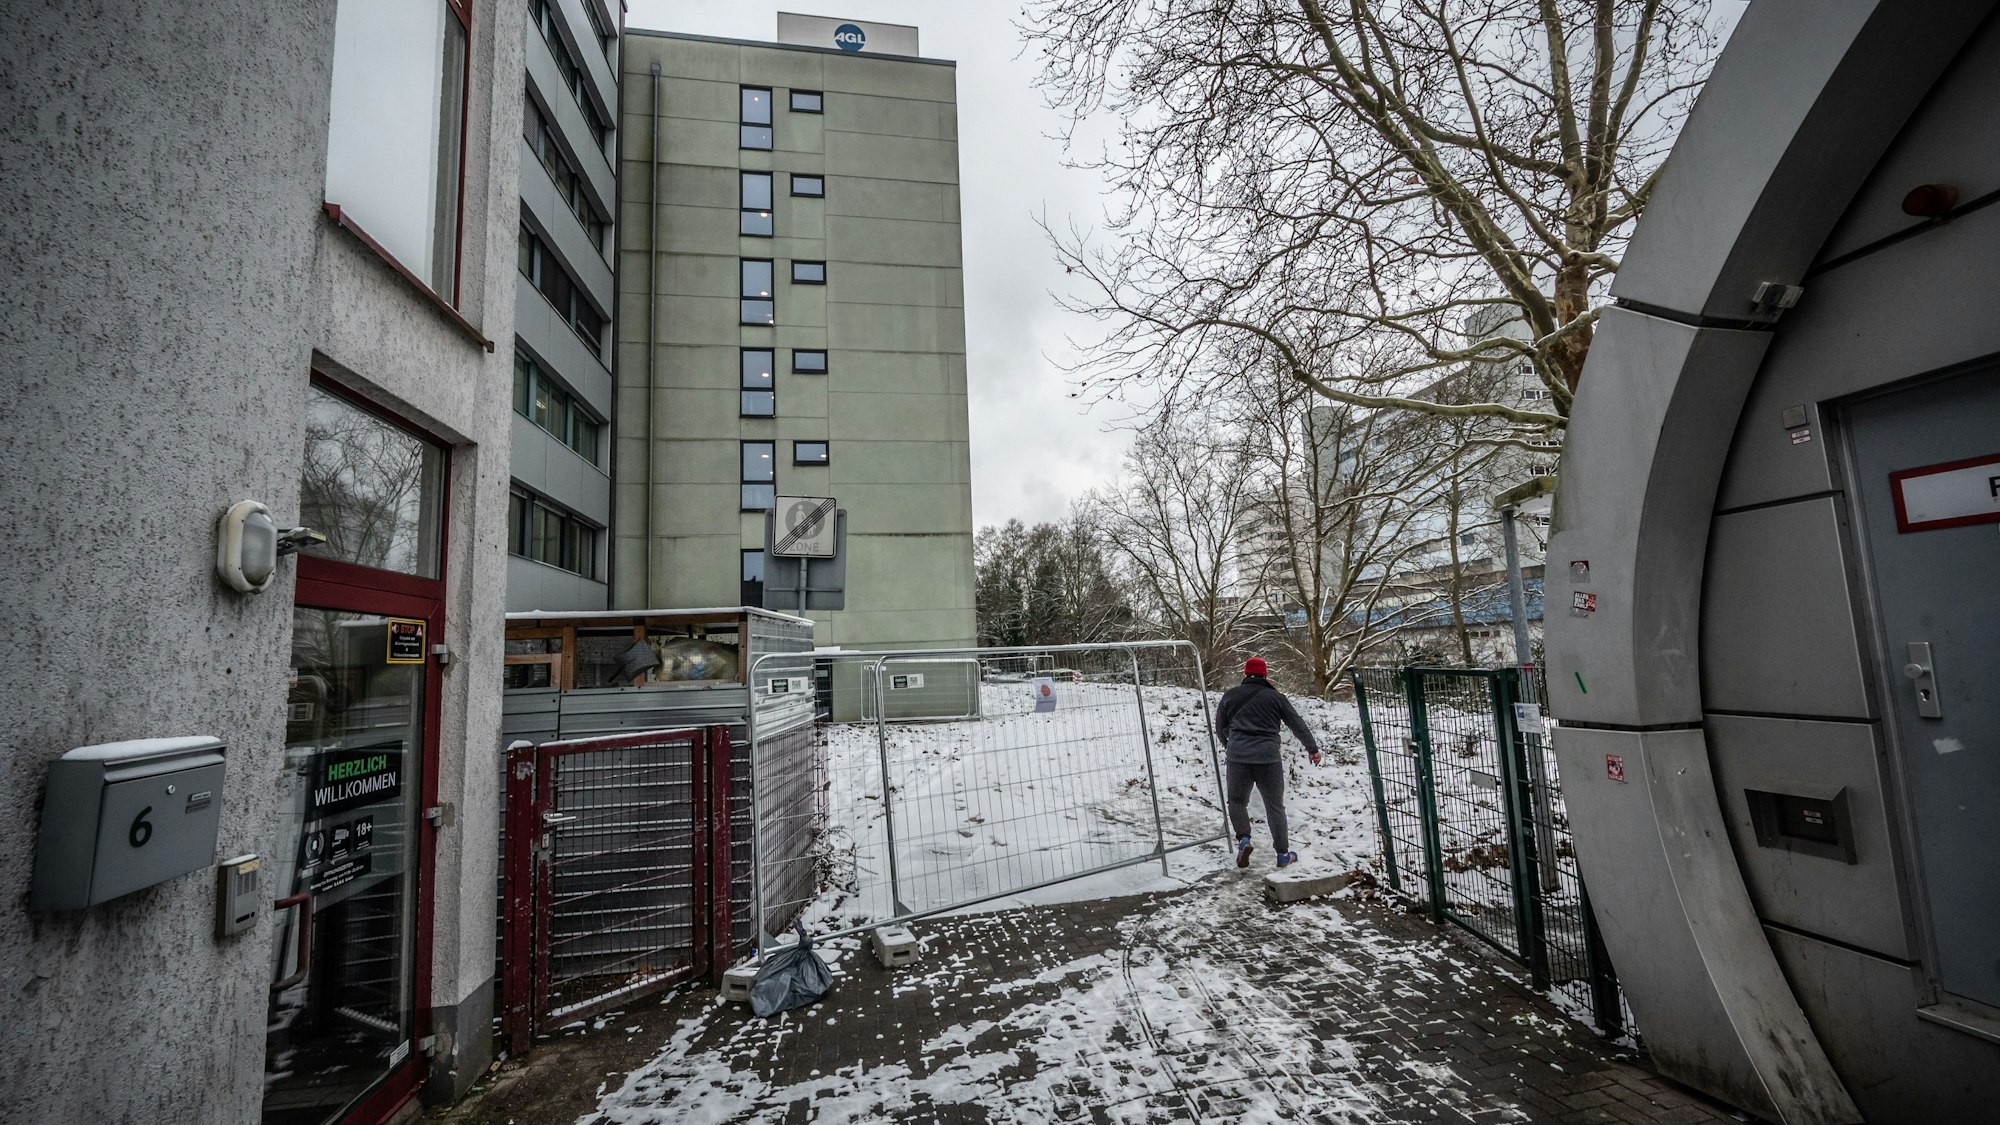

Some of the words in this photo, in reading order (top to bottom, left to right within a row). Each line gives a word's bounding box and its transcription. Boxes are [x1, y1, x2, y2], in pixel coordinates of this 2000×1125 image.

[834, 32, 865, 44] AGL
[789, 542, 819, 552] ZONE
[400, 624, 415, 634] STOP
[328, 754, 387, 781] HERZLICH
[315, 771, 396, 806] WILLKOMMEN
[129, 806, 152, 848] 6
[356, 822, 373, 837] 18+
